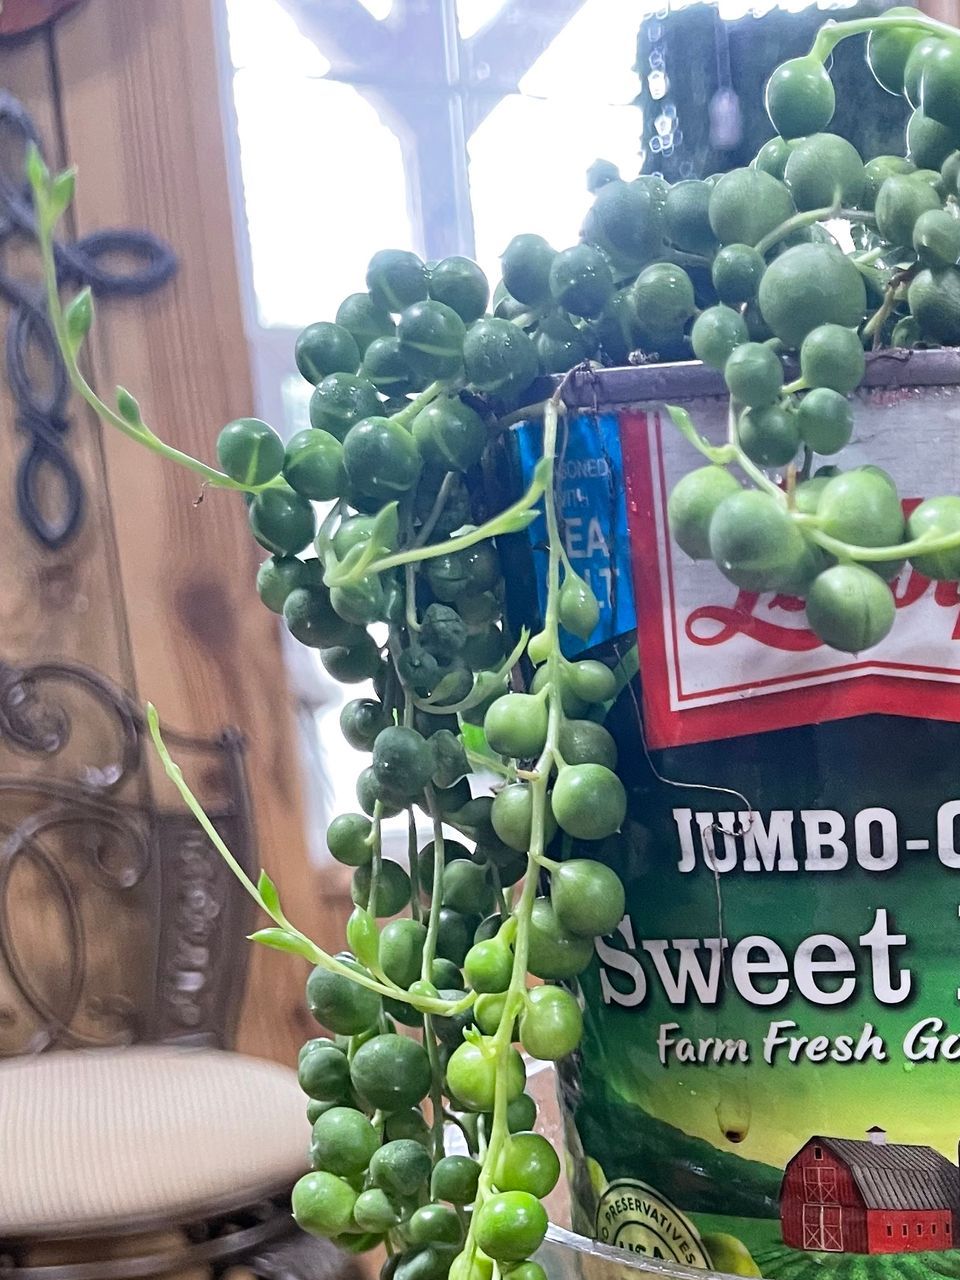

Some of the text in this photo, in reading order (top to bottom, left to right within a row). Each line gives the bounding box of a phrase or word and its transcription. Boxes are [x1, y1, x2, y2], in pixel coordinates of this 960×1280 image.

[564, 517, 610, 558] EA
[594, 906, 913, 1007] Sweet
[657, 1022, 750, 1064] Farm
[764, 1020, 888, 1063] Fresh
[604, 1197, 697, 1264] PRESERVATIVES
